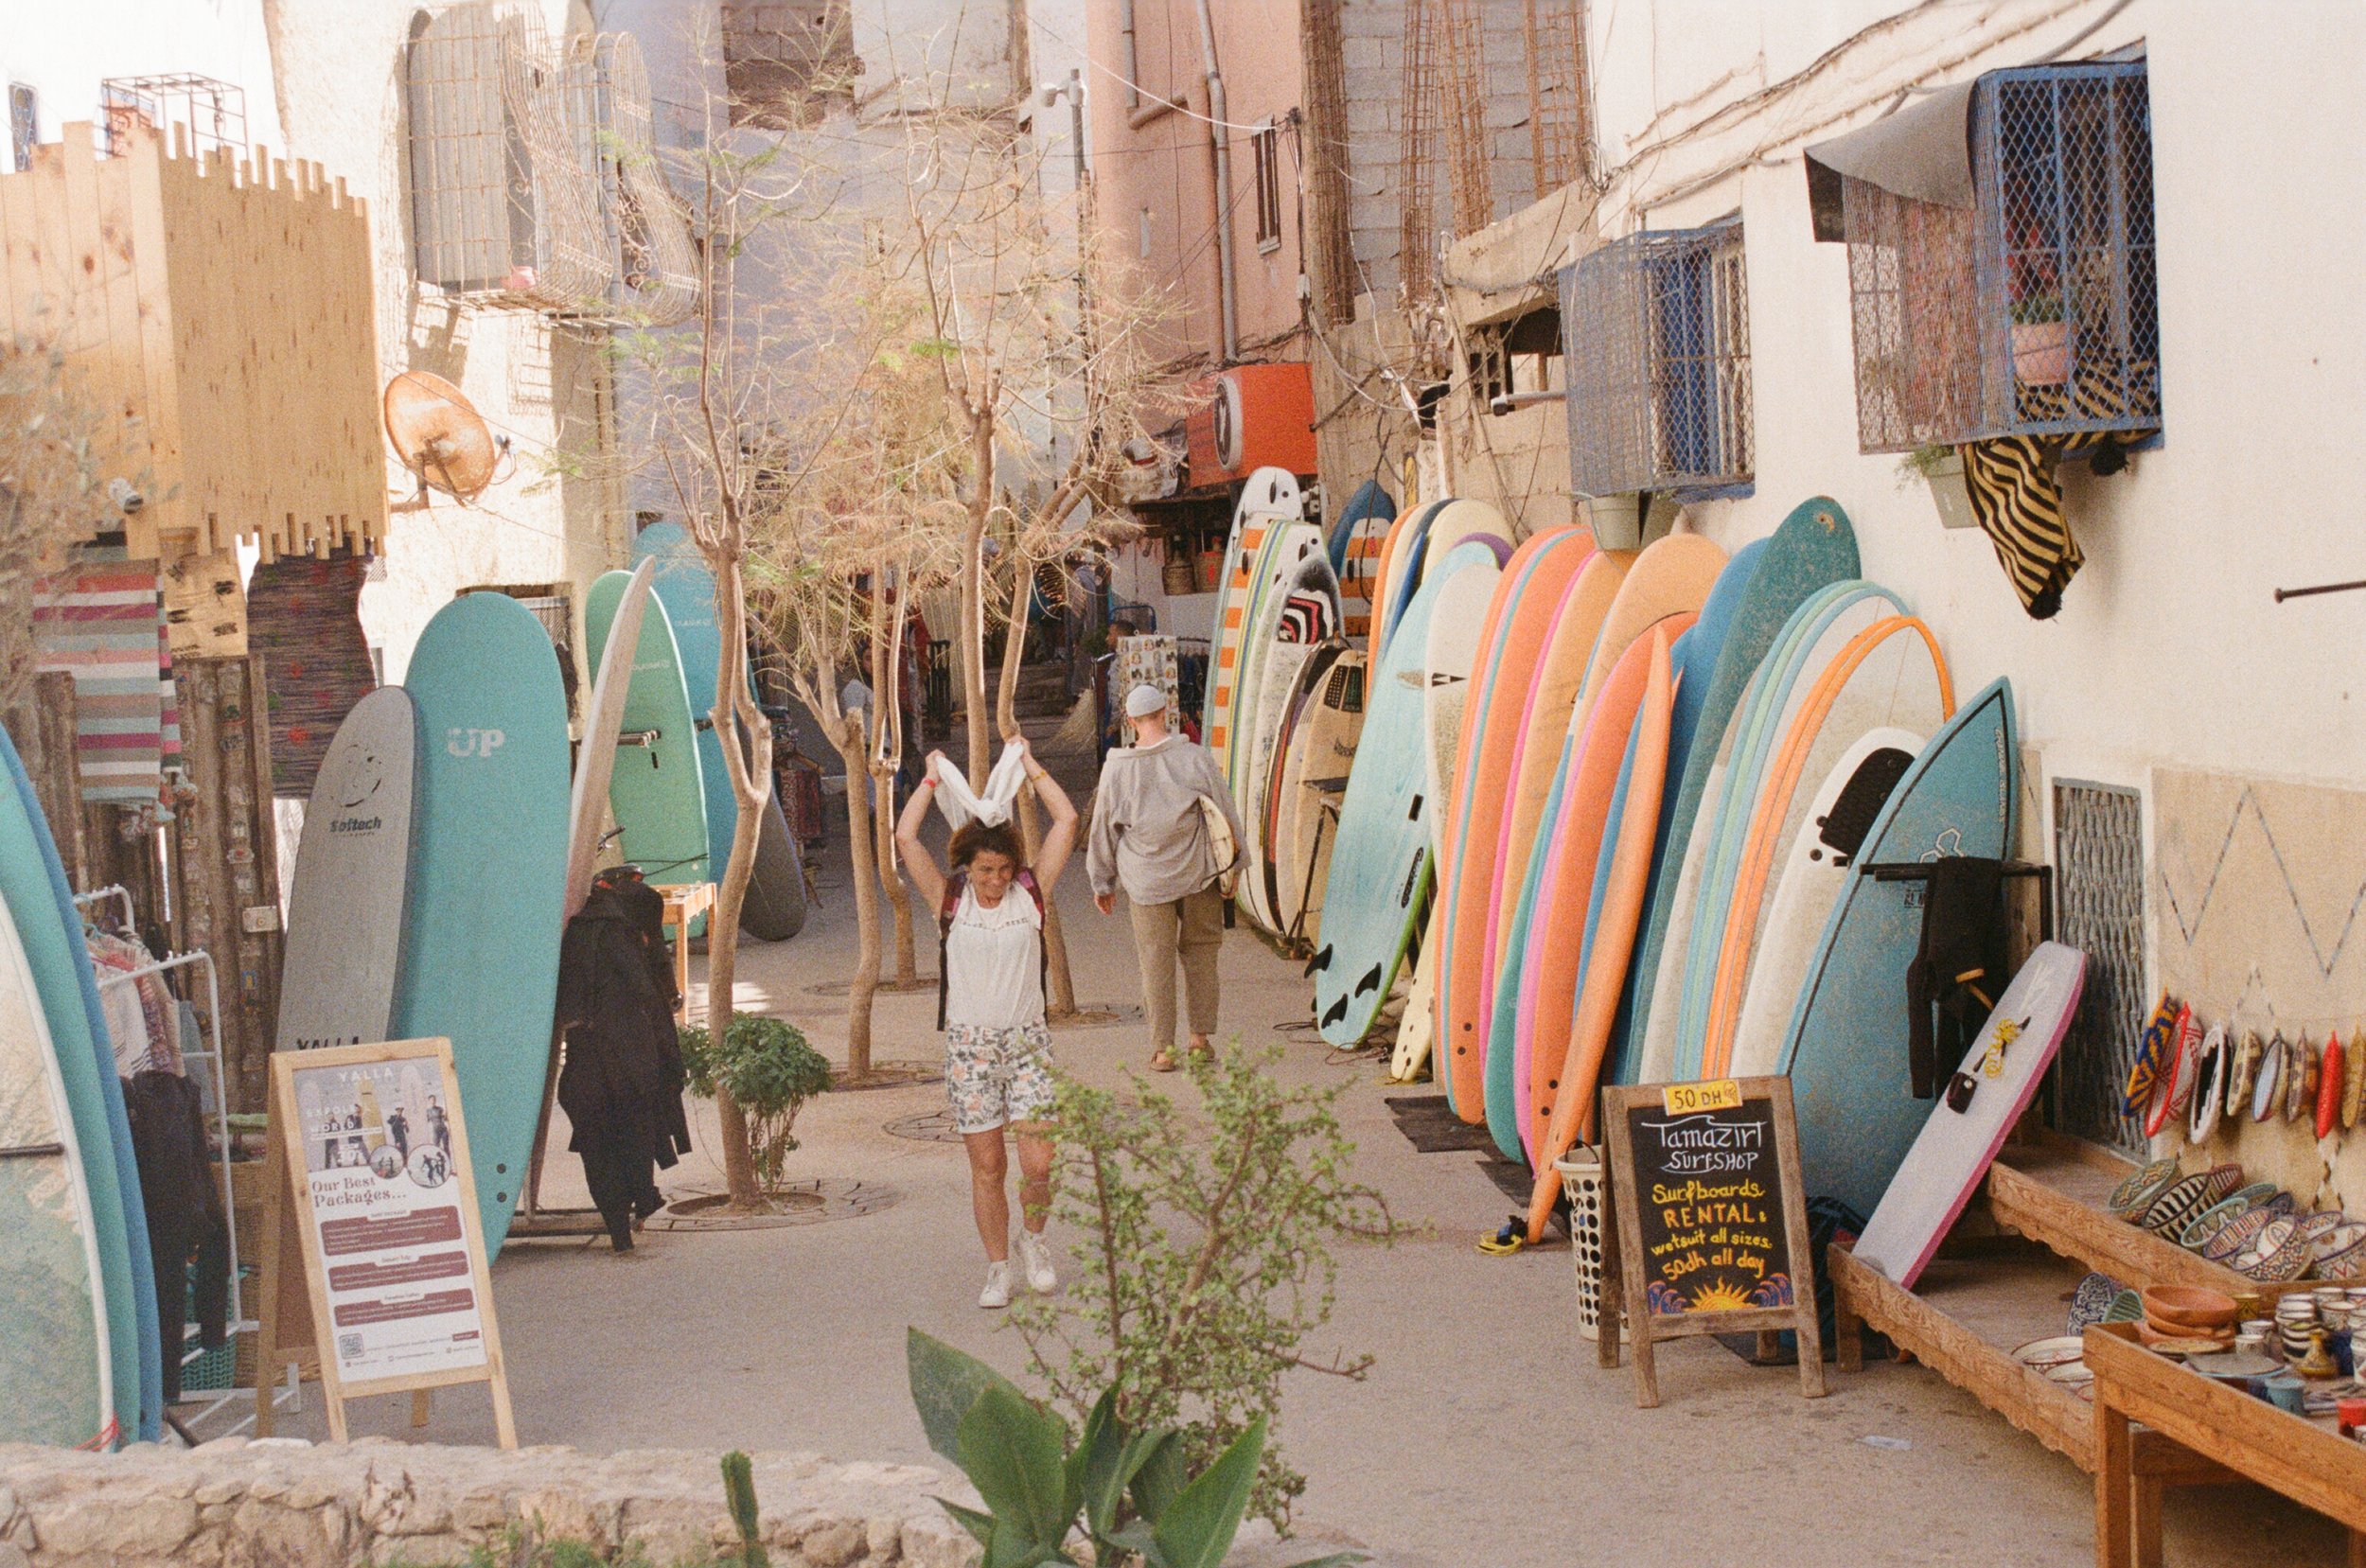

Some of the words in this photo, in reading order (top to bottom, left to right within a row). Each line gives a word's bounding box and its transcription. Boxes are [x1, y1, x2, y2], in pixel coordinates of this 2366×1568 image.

[329, 816, 382, 834] Softech
[338, 1066, 396, 1083] YALLA
[1674, 1088, 1696, 1110] 50
[1701, 1090, 1722, 1105] DH
[312, 1180, 340, 1192] Our
[344, 1176, 376, 1189] Best
[313, 1189, 407, 1207] Packages...
[1664, 1202, 1755, 1228] RENTAL
[1651, 1228, 1705, 1256] wetsuit
[1710, 1226, 1727, 1243] all
[1662, 1250, 1707, 1281] 50dh
[1711, 1247, 1733, 1265] all
[1736, 1249, 1764, 1278] day
